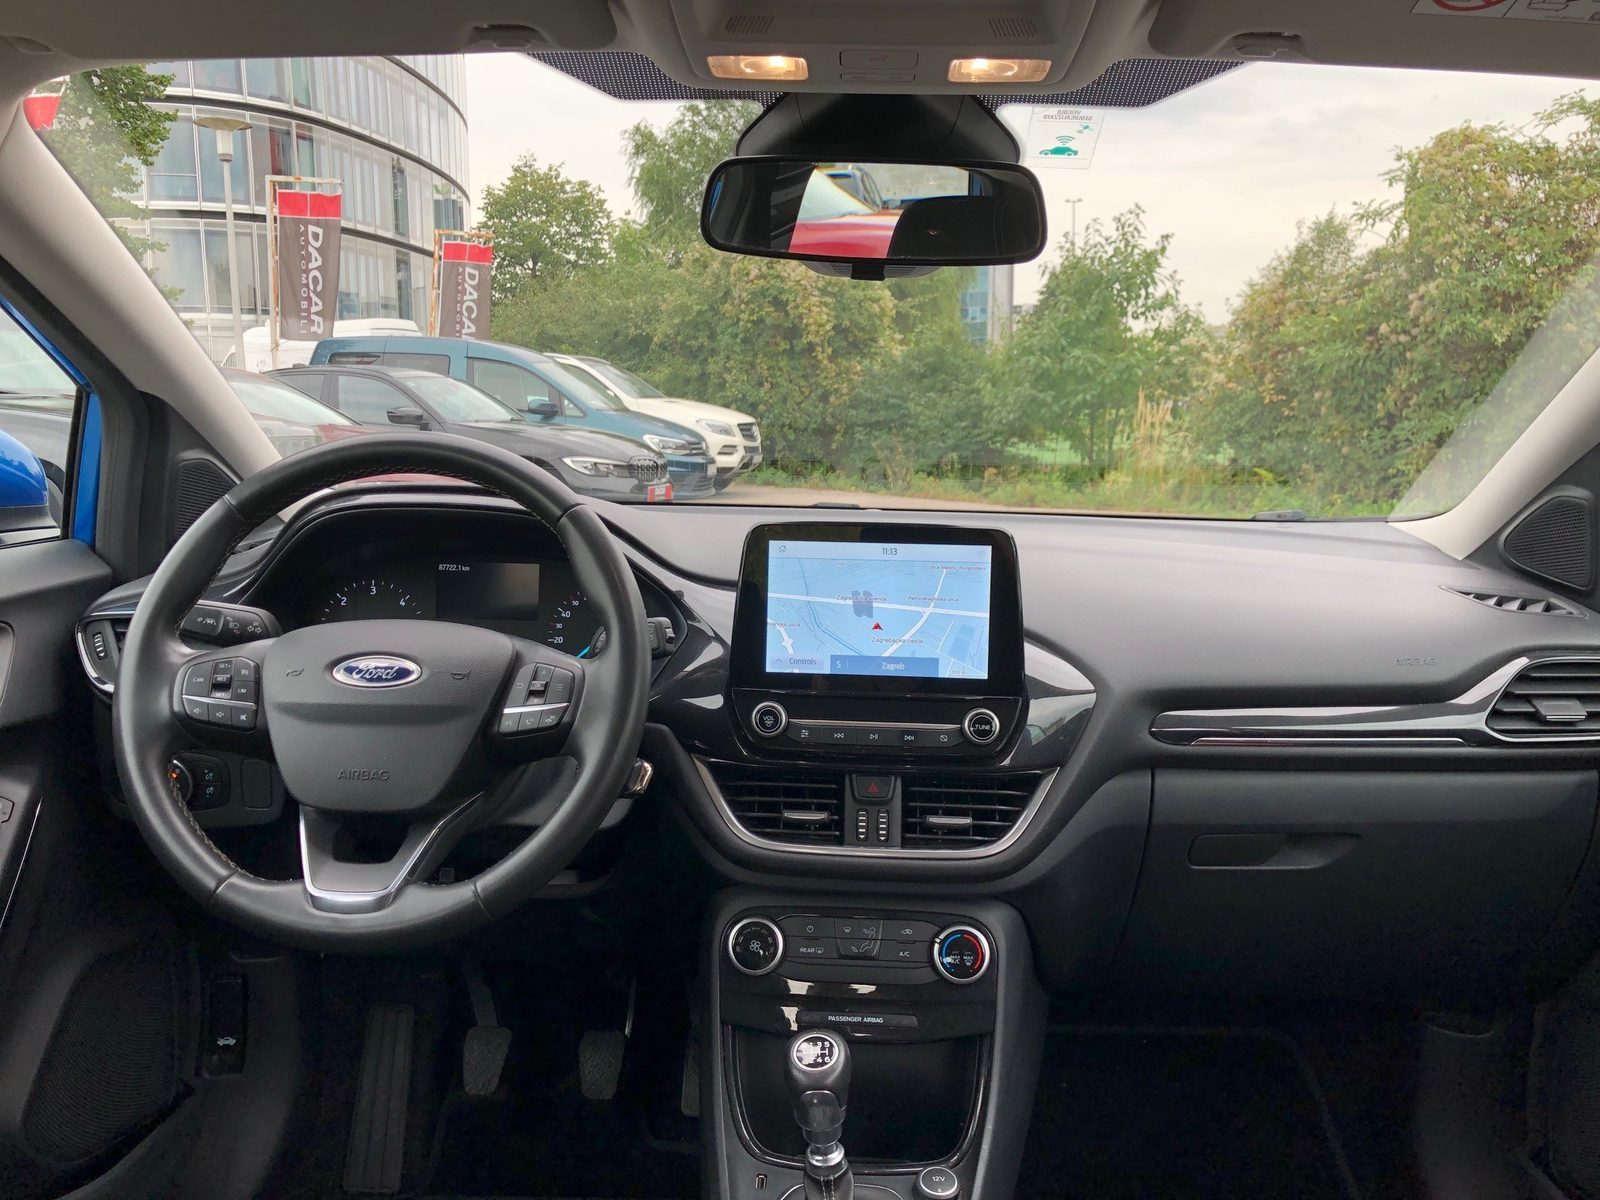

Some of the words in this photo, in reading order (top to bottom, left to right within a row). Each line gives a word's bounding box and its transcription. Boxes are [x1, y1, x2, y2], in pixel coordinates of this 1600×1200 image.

[299, 224, 308, 334] AUTOMOBILI
[307, 224, 324, 335] DACAR
[881, 547, 898, 556] 11:13
[370, 586, 376, 595] 3
[341, 597, 347, 606] 2
[400, 598, 406, 607] 4
[561, 610, 571, 618] 40
[553, 636, 564, 644] 20
[789, 656, 817, 665] Controls
[352, 661, 400, 680] Ford
[882, 662, 905, 670] Zagreb
[338, 767, 391, 781] AIRBAG
[828, 1015, 862, 1023] PASSENGER
